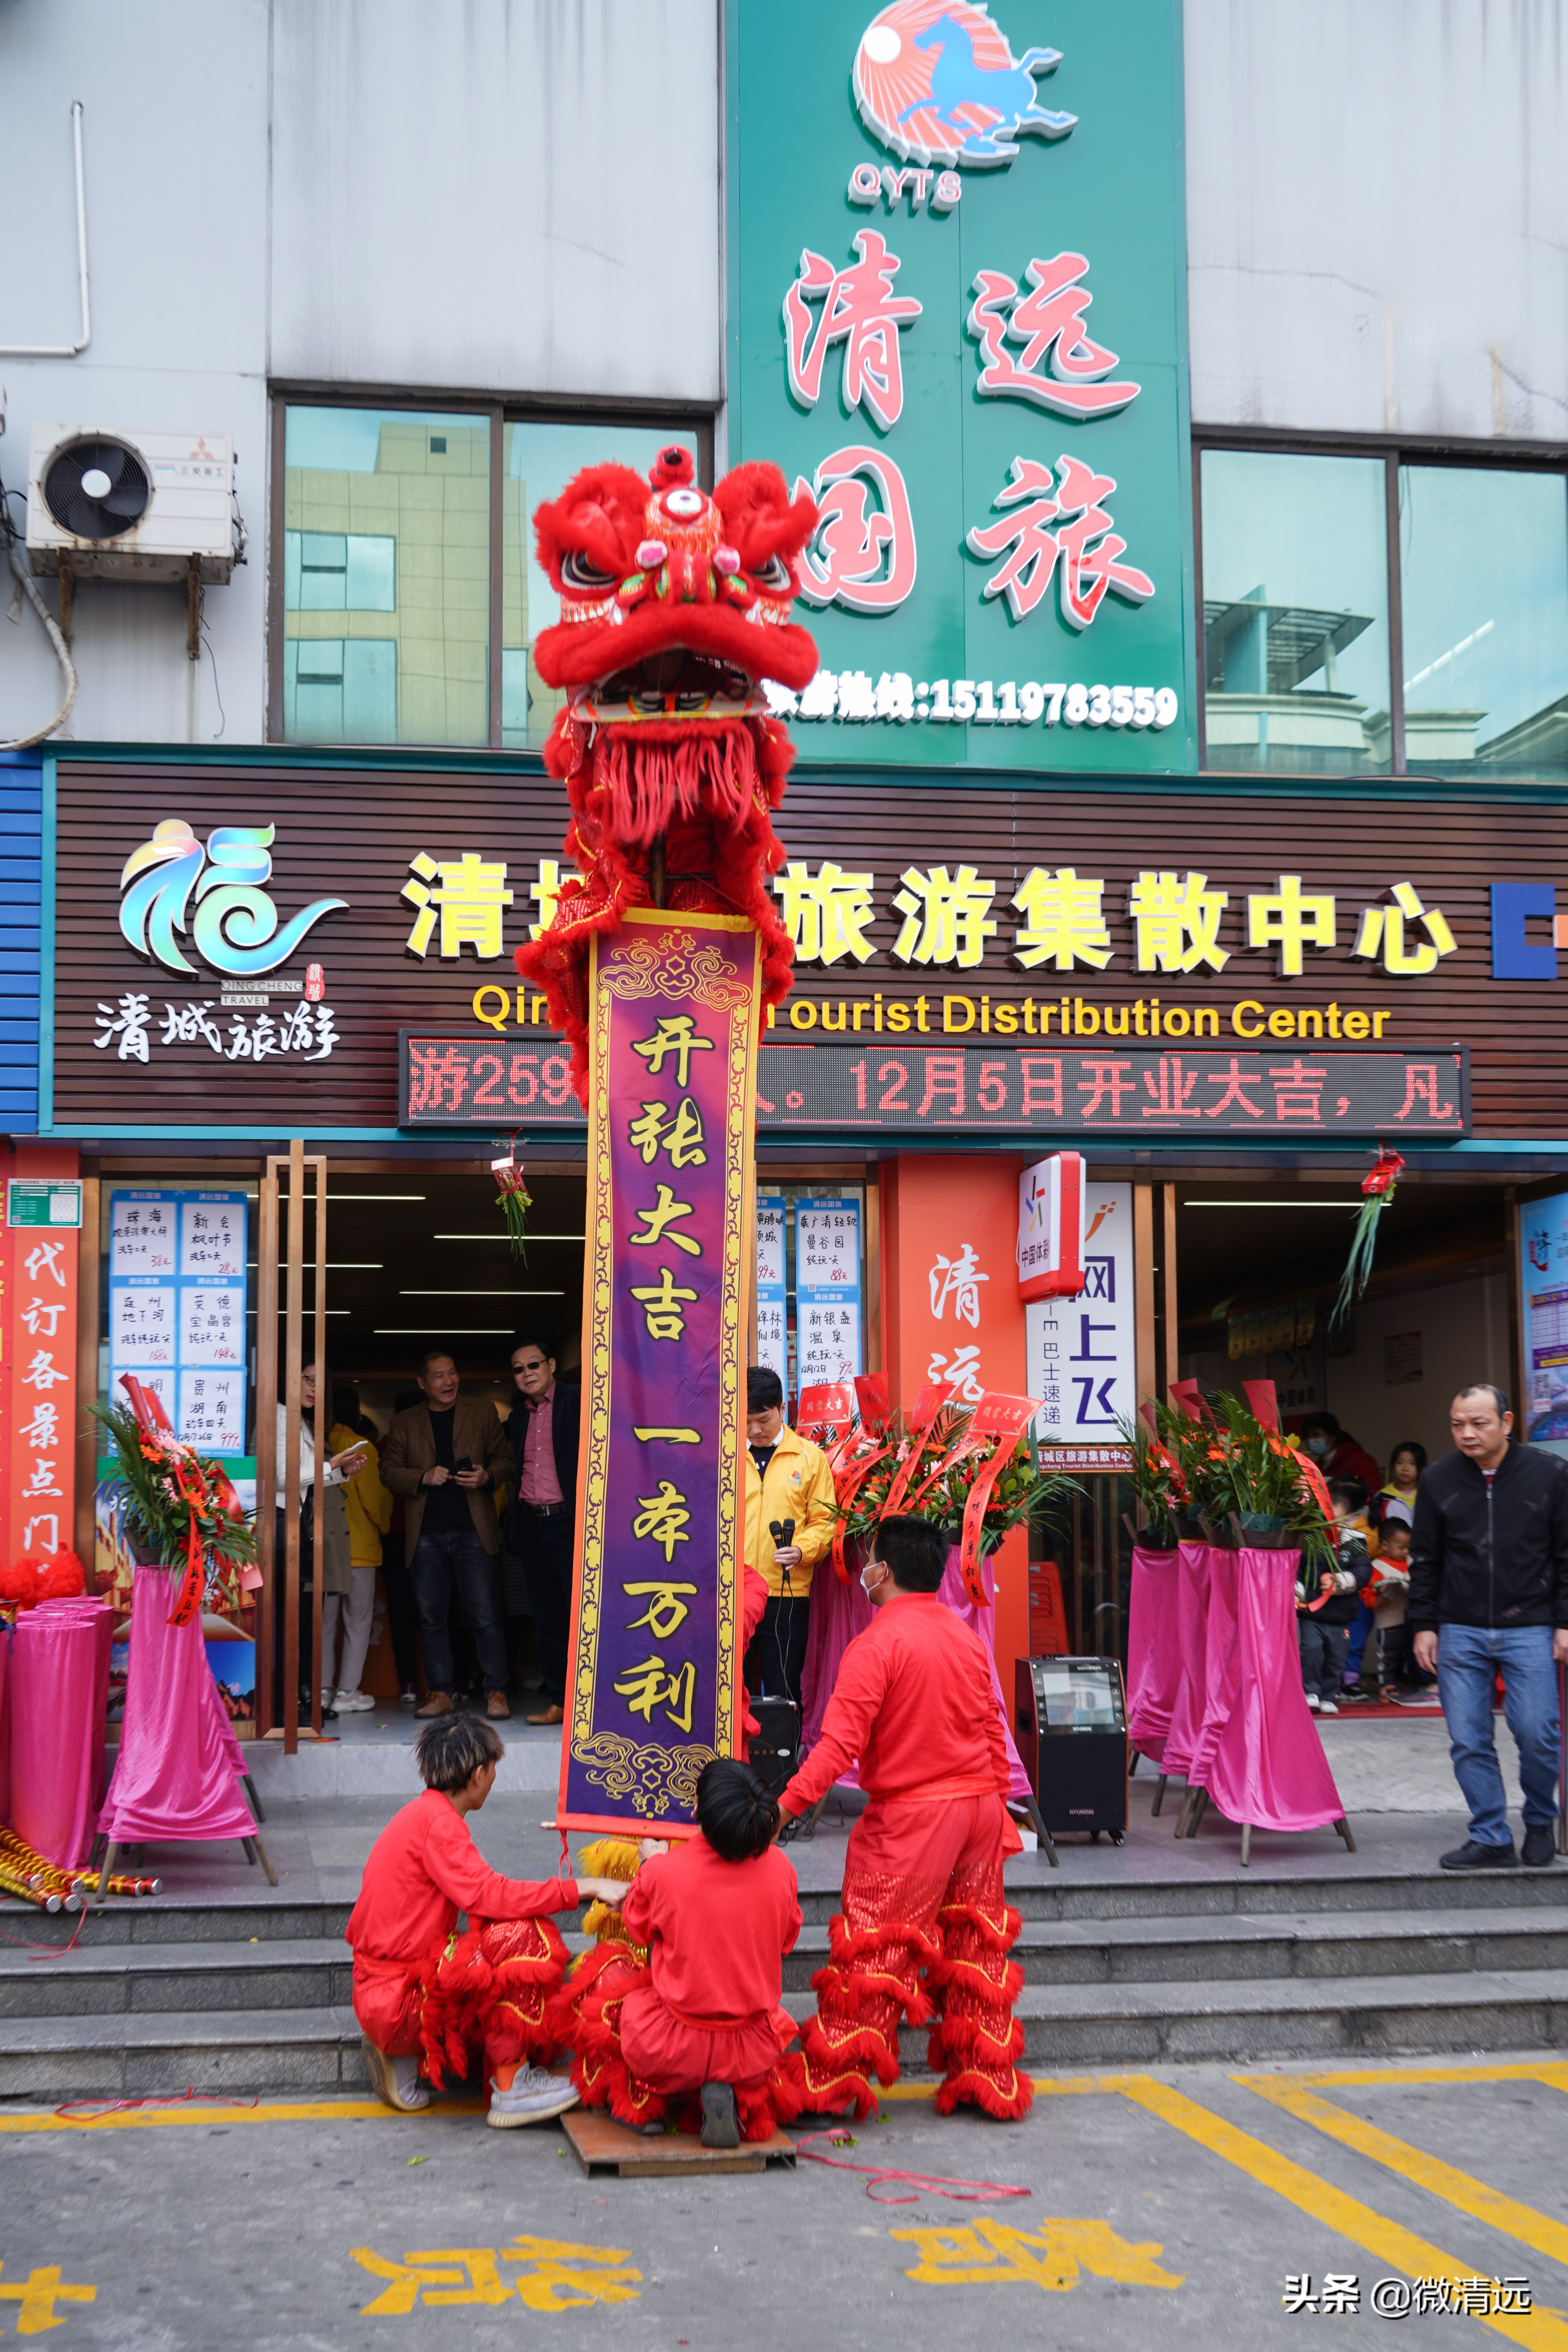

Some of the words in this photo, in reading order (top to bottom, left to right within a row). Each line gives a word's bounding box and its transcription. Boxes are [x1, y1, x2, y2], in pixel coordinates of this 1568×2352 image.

[848, 162, 962, 212] QYTS
[784, 229, 1142, 431] 清远
[788, 445, 1155, 630] 国旅
[773, 862, 1458, 979] 旅游集散中心
[222, 981, 255, 991] QING
[258, 981, 303, 991] CHENG
[222, 996, 268, 1005] TRAVEL
[93, 993, 340, 1063] 清城旅游
[472, 985, 550, 1031] Qin
[943, 995, 1218, 1037] Distribution
[1232, 1000, 1391, 1039] Center
[191, 1233, 232, 1247] 枫叶节
[1022, 1239, 1049, 1268] 中国体彩
[806, 1255, 838, 1265] 纯玩一天
[831, 1268, 847, 1281] 88元
[809, 1329, 845, 1344] 温泉
[927, 1243, 989, 1413] 清远
[1068, 1256, 1118, 1425] 网上飞
[801, 1365, 826, 1374] 12月12日
[807, 1350, 845, 1360] 纯玩一天
[839, 1361, 853, 1376] 99元
[1043, 1343, 1060, 1424] 巴士速递
[19, 1241, 69, 1572] 代订各景点门
